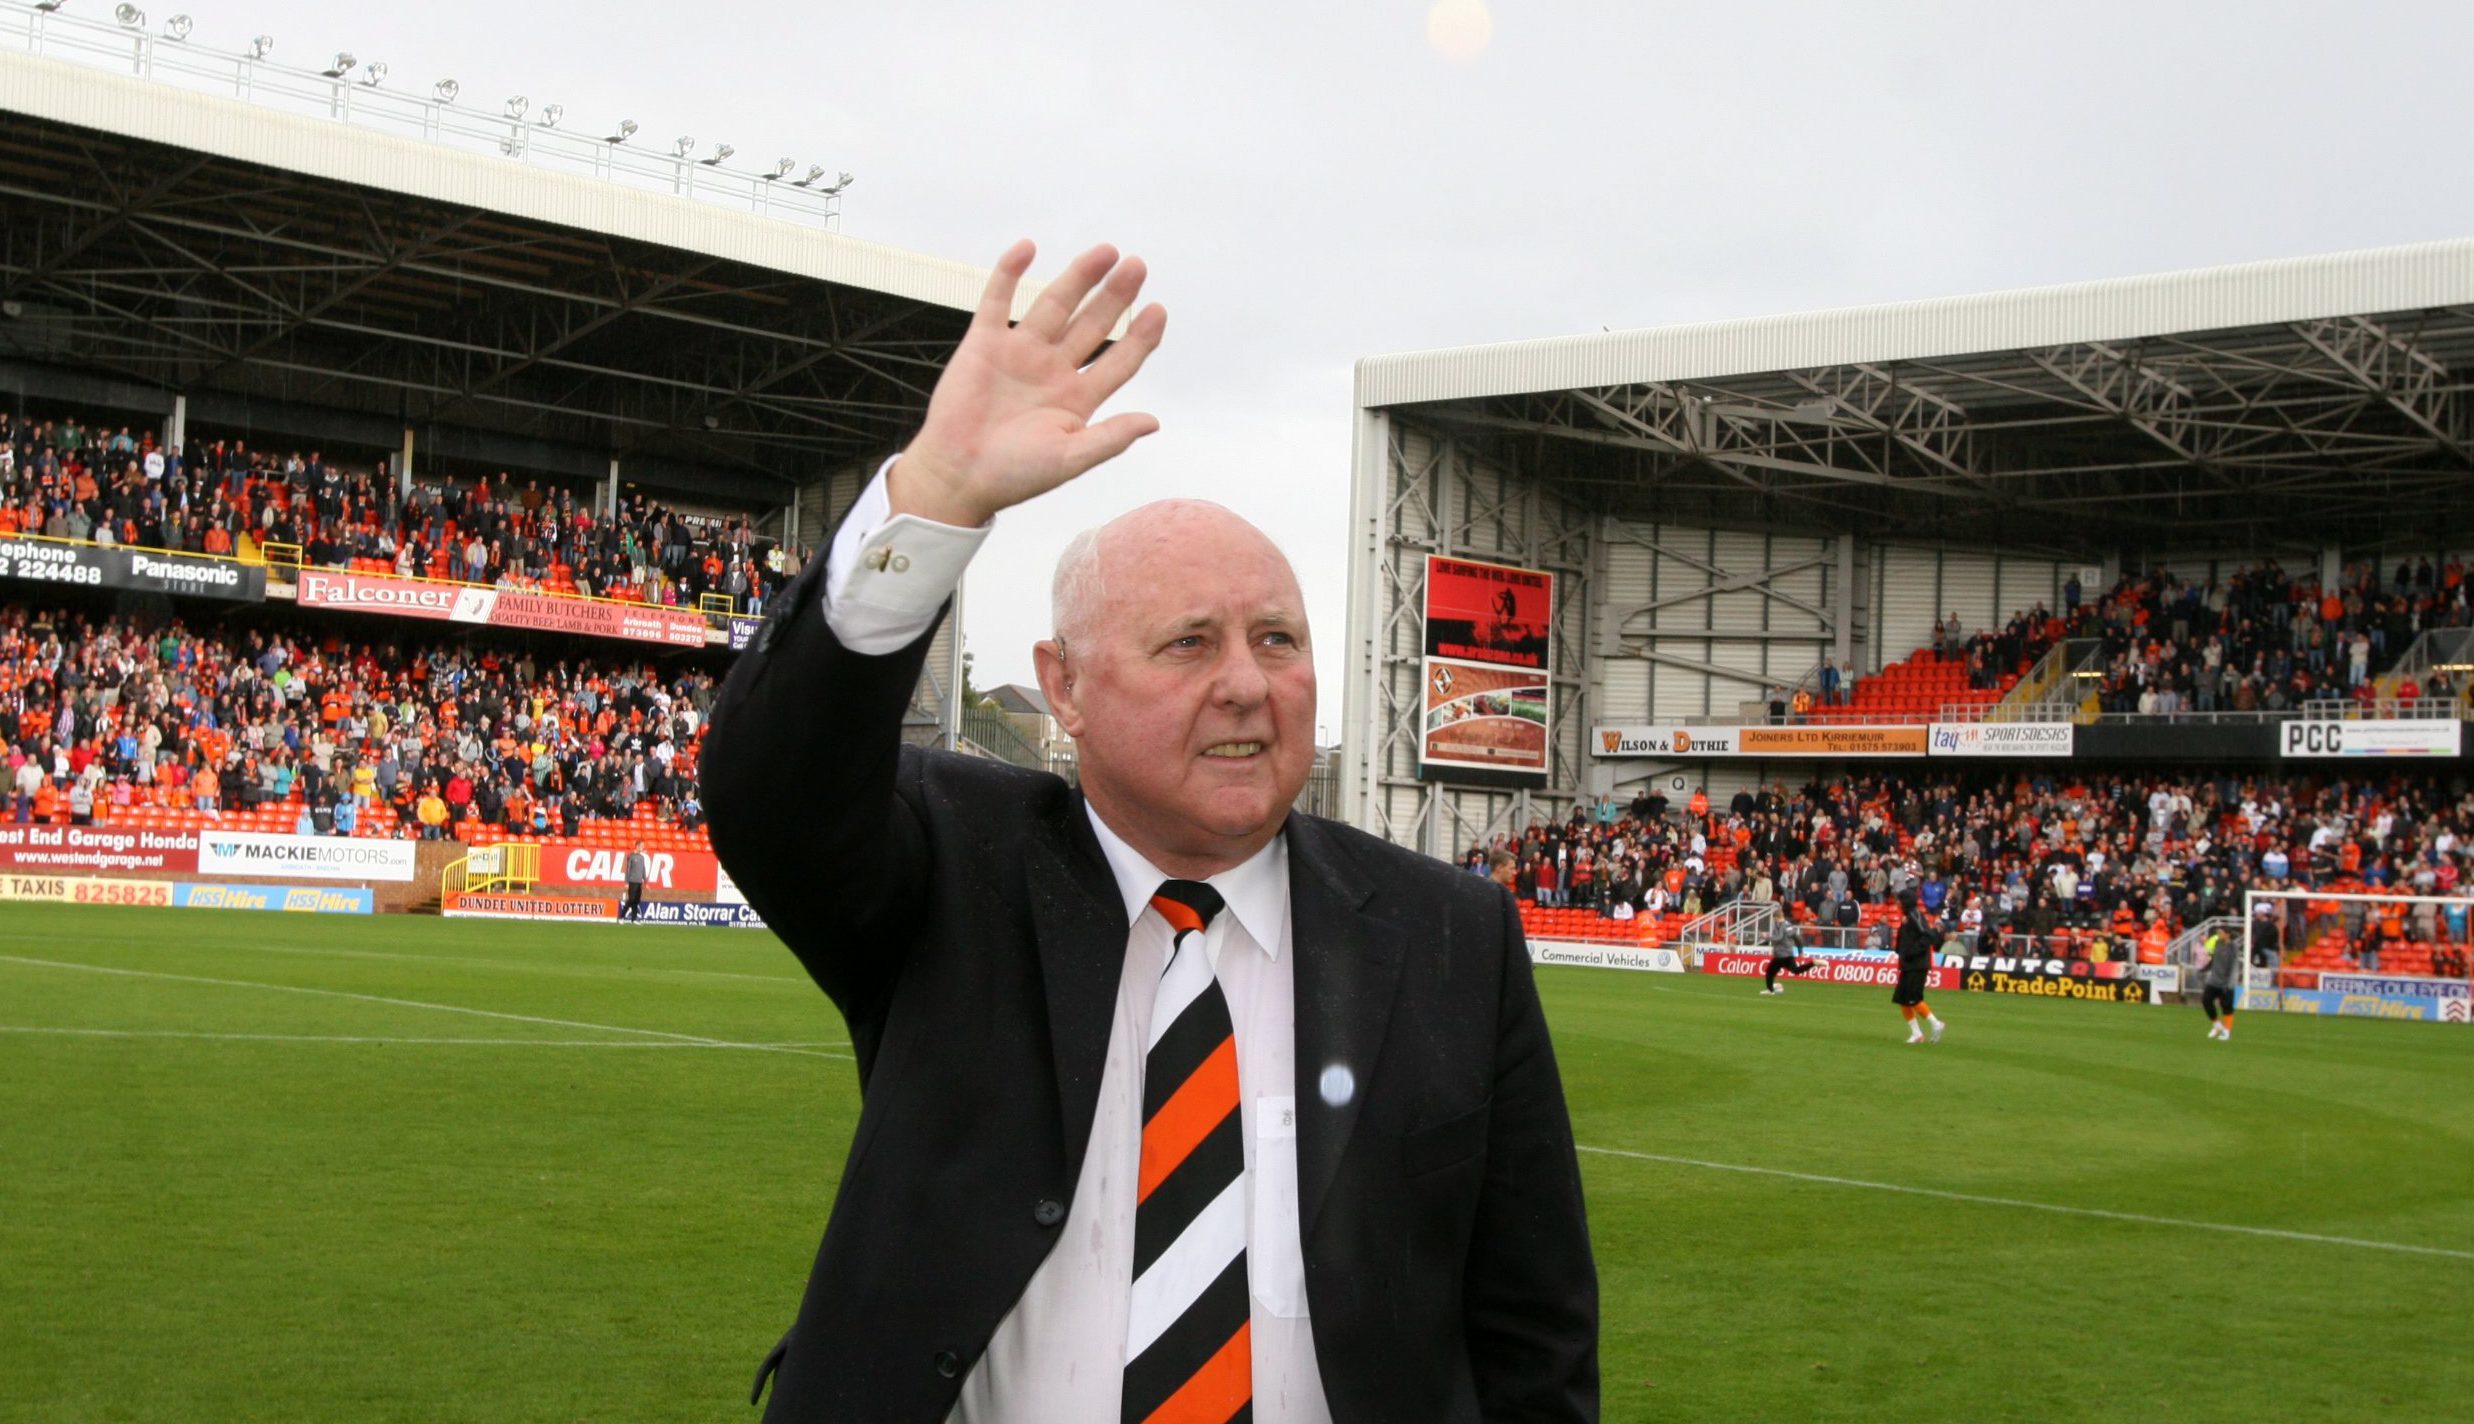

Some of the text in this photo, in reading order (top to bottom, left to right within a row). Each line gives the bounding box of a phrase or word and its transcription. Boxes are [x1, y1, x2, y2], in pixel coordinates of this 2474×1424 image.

[18, 559, 101, 584] 224488
[132, 555, 238, 585] Panasonic
[164, 579, 205, 592] STORE
[305, 577, 452, 607] Falconer
[499, 596, 613, 620] FAMILY BUTCHERS
[624, 609, 703, 624] TELEPHONE
[490, 611, 530, 625] QUALITY
[557, 619, 583, 631] LAMB
[593, 623, 618, 634] PORK
[1602, 730, 1729, 753] WILSON & DUTHIE
[1749, 732, 1794, 742] JOINERS
[1797, 732, 1818, 742] LTD
[1850, 743, 1879, 751] 01575
[2289, 724, 2341, 753] PCC
[1672, 776, 1685, 791] Q
[29, 828, 63, 845] End
[68, 829, 136, 851] Garage
[140, 832, 198, 850] Honda
[14, 850, 164, 869] www.westendgarage.net
[11, 878, 65, 896] TAXIS
[74, 883, 167, 906] 825825
[459, 897, 605, 915] DUNDEE UNITED LOTTERY
[644, 902, 679, 919] Alan
[683, 904, 735, 922] Storrar
[1541, 949, 1650, 968] Commercial Vehicles
[1718, 957, 1756, 975] Calor
[1834, 964, 1874, 983] 0800
[1992, 973, 2117, 1001] TradePoint
[2325, 980, 2381, 996] KEEPING
[2384, 984, 2416, 997] OUR
[2420, 986, 2445, 997] EYE
